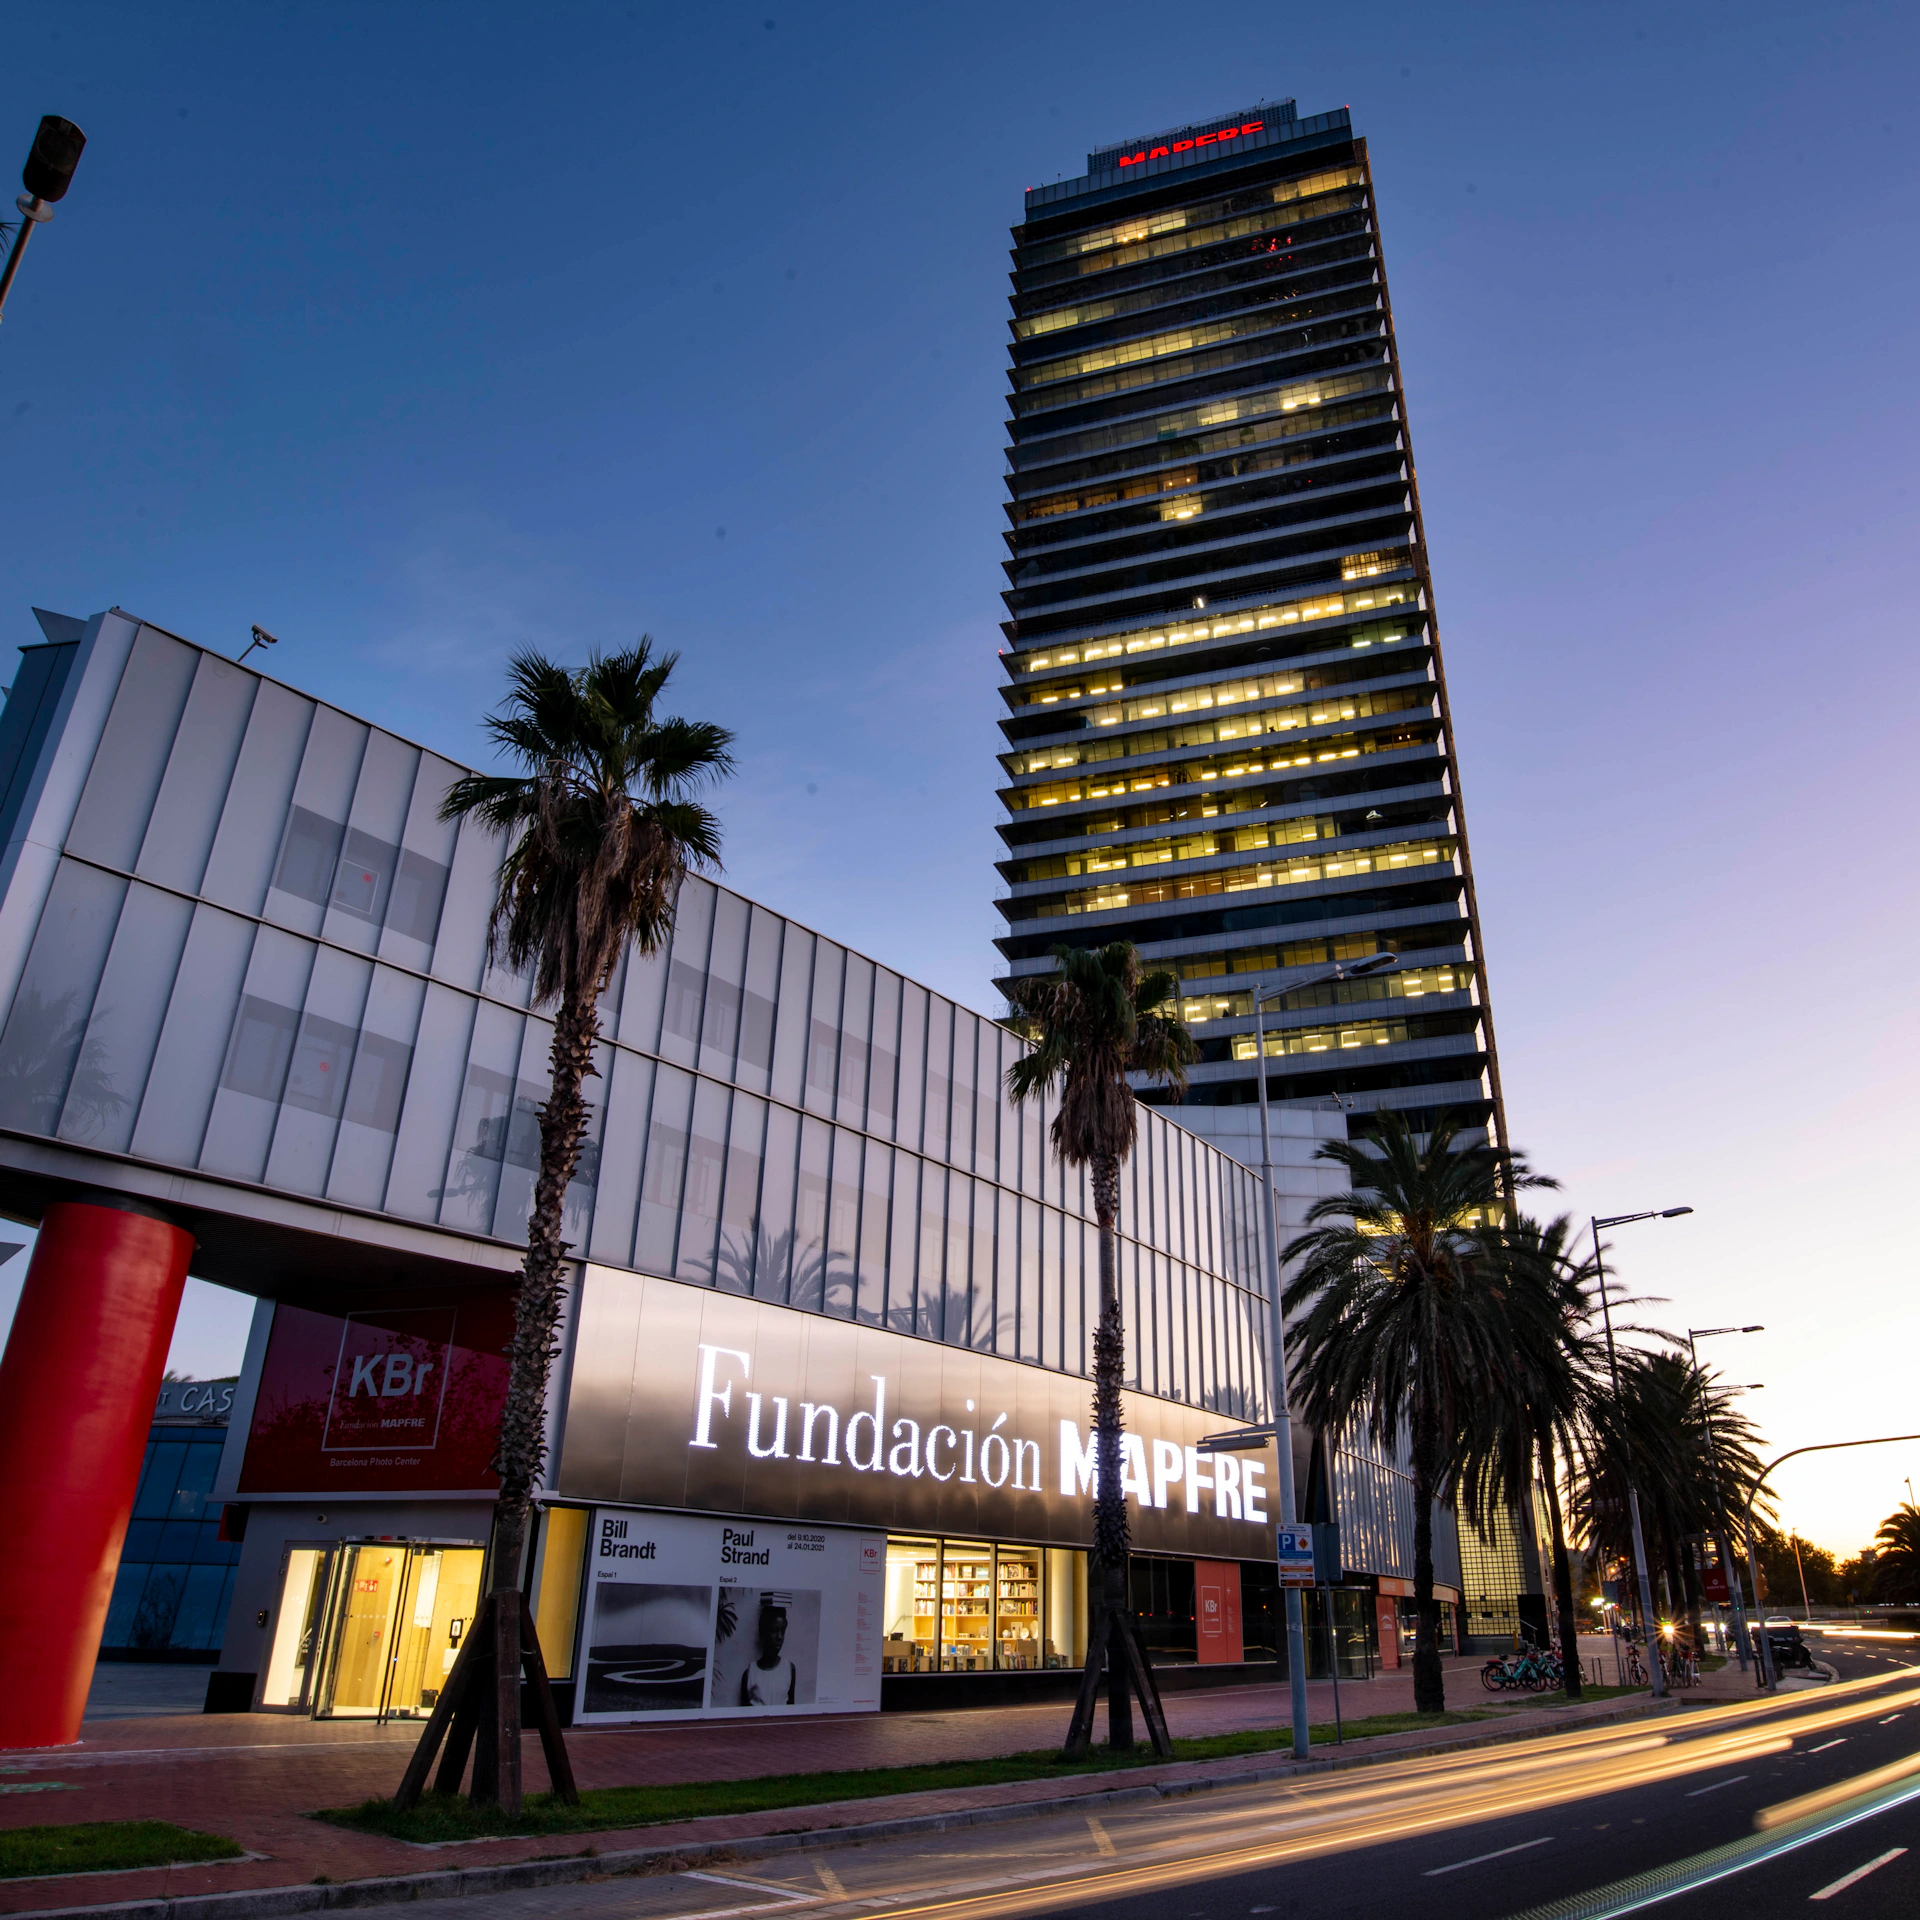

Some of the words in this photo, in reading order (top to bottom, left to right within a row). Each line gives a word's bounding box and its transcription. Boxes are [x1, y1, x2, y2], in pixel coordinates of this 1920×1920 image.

[349, 1353, 434, 1397] KBr
[340, 1419, 379, 1430] Fundación
[381, 1418, 426, 1429] MAPFRE
[688, 1343, 1042, 1492] Fundación
[1060, 1419, 1268, 1524] MAPFRE
[330, 1457, 368, 1467] Barcelona
[370, 1457, 393, 1466] Photo
[395, 1456, 421, 1466] Center
[602, 1519, 629, 1539] Bill
[722, 1527, 754, 1547] Paul
[787, 1533, 797, 1541] del
[798, 1534, 825, 1543] 9.10.2020
[1282, 1535, 1292, 1550] P
[600, 1538, 656, 1560] Brandt
[787, 1542, 793, 1550] al
[794, 1542, 825, 1552] 24.01.2021
[864, 1548, 877, 1558] KBr
[721, 1546, 770, 1565] Strand
[597, 1571, 614, 1580] Espai
[719, 1576, 733, 1584] Espai
[1205, 1599, 1218, 1613] KBr
